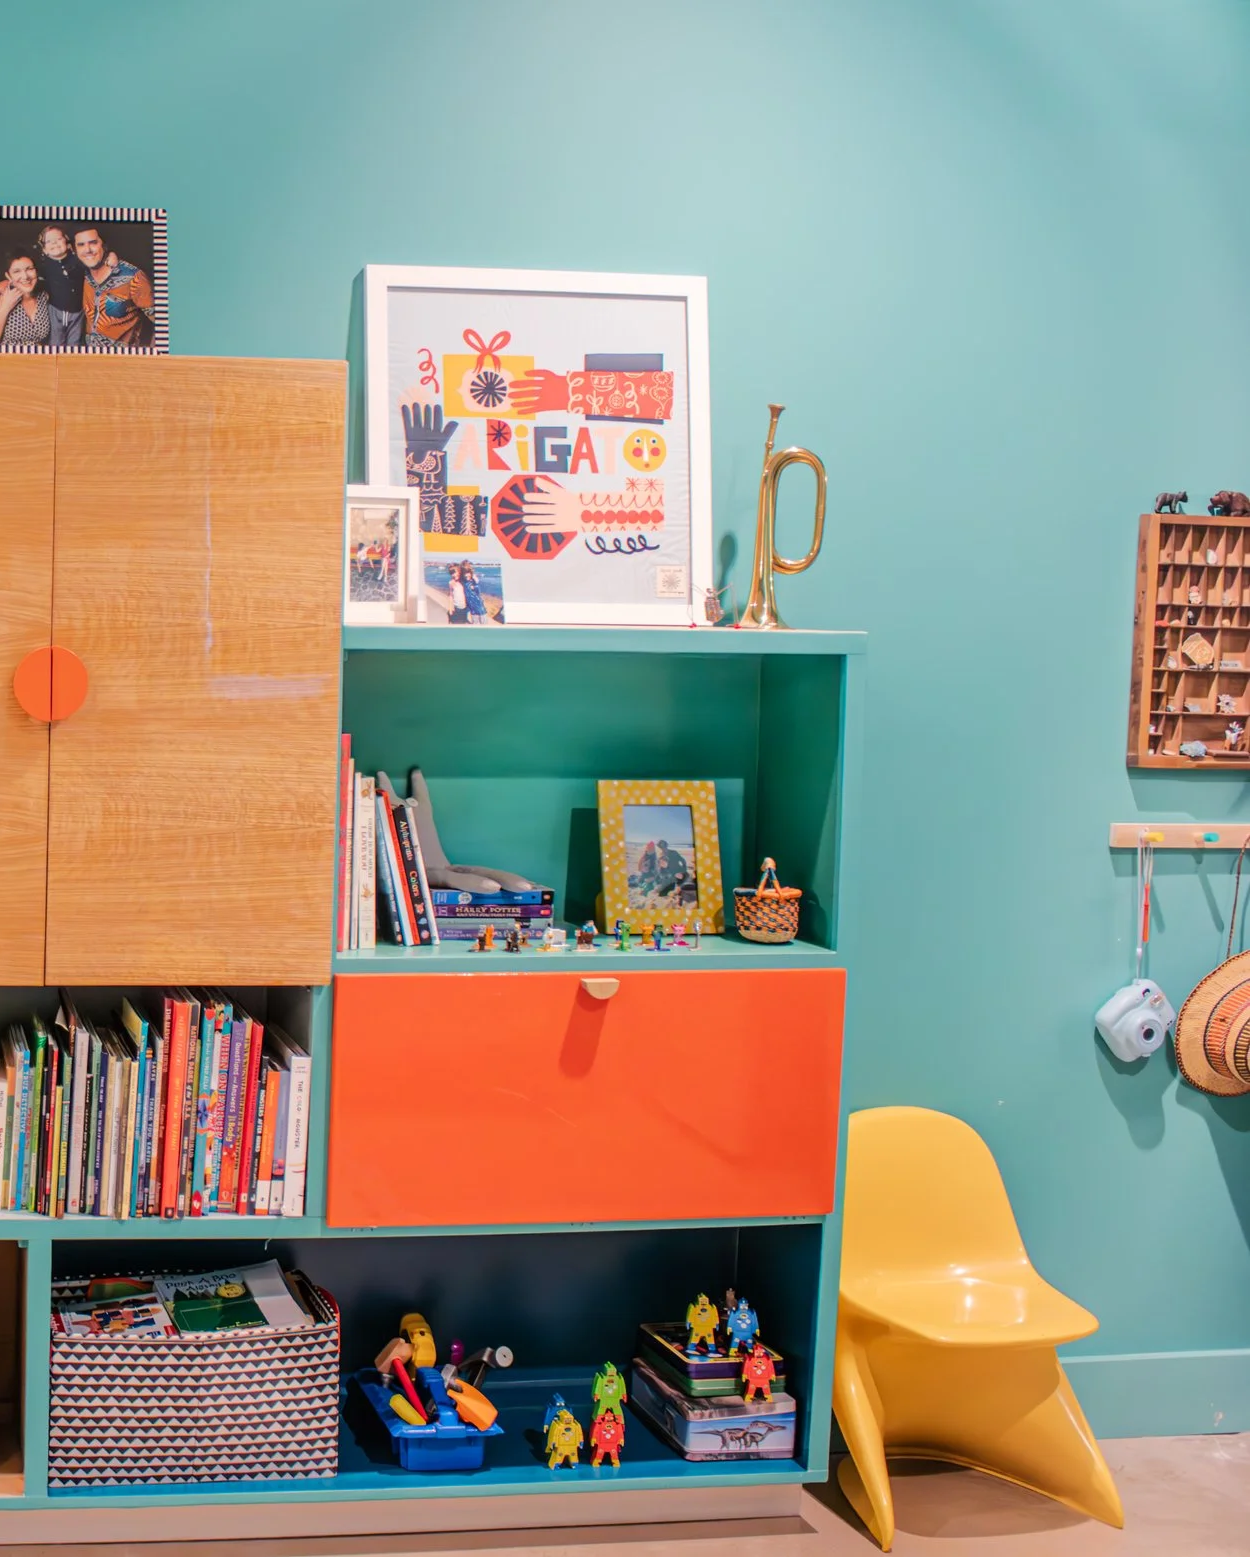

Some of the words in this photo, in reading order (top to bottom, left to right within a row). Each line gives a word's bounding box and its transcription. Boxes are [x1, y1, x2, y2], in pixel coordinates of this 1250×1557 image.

[400, 820, 413, 861] Alphaprints
[409, 870, 420, 898] Colors
[490, 906, 521, 914] POTTER
[163, 1021, 171, 1054] ELEVENTH
[189, 1025, 198, 1060] NATIONAL
[220, 1034, 230, 1070] WHEN
[187, 1061, 195, 1083] PARKS
[233, 1042, 242, 1076] Questions
[218, 1073, 228, 1091] ON
[20, 1093, 28, 1133] DETECTIVE
[184, 1100, 192, 1120] U.S.A.
[229, 1083, 238, 1113] Answers
[258, 1089, 266, 1117] MONSTERS
[214, 1092, 227, 1139] EARTH?
[256, 1118, 264, 1135] AFTER
[225, 1121, 236, 1143] Body
[293, 1118, 302, 1149] MONSTER
